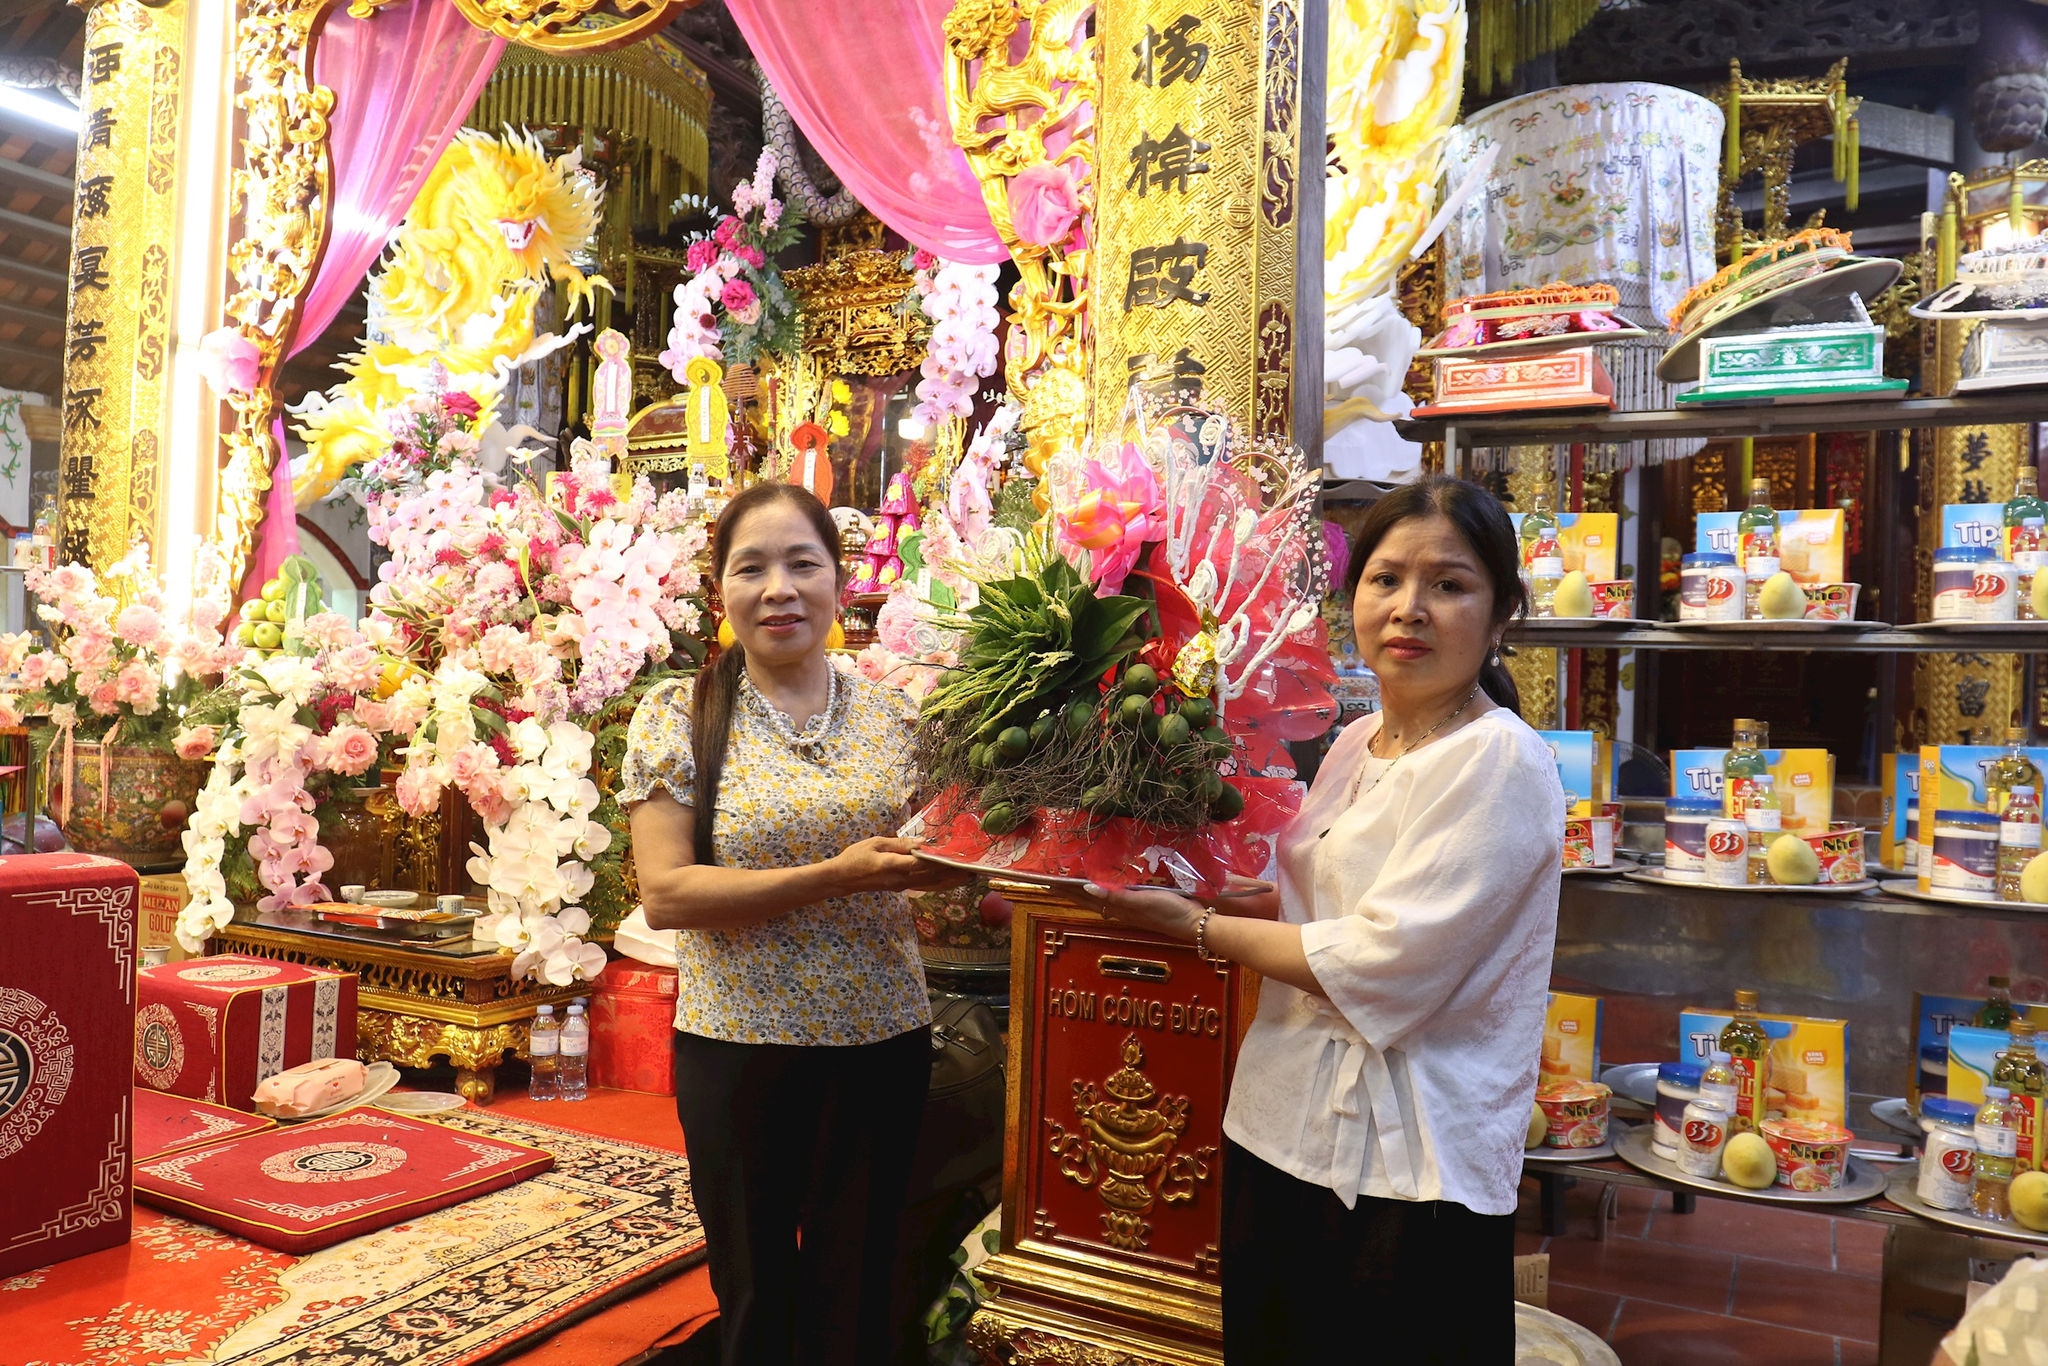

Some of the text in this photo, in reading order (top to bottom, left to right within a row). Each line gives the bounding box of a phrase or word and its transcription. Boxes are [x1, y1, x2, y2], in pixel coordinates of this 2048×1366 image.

[1706, 528, 1739, 554] Tip
[1954, 521, 2002, 548] Tip
[1707, 577, 1728, 600] 333
[1975, 572, 1998, 596] 333
[1686, 768, 1725, 795] Tip
[1712, 830, 1740, 853] 333
[143, 896, 179, 912] MEIZAN
[1102, 986, 1164, 1027] CÔNG
[1171, 995, 1219, 1036] ĐỨC
[1687, 1120, 1718, 1143] 333
